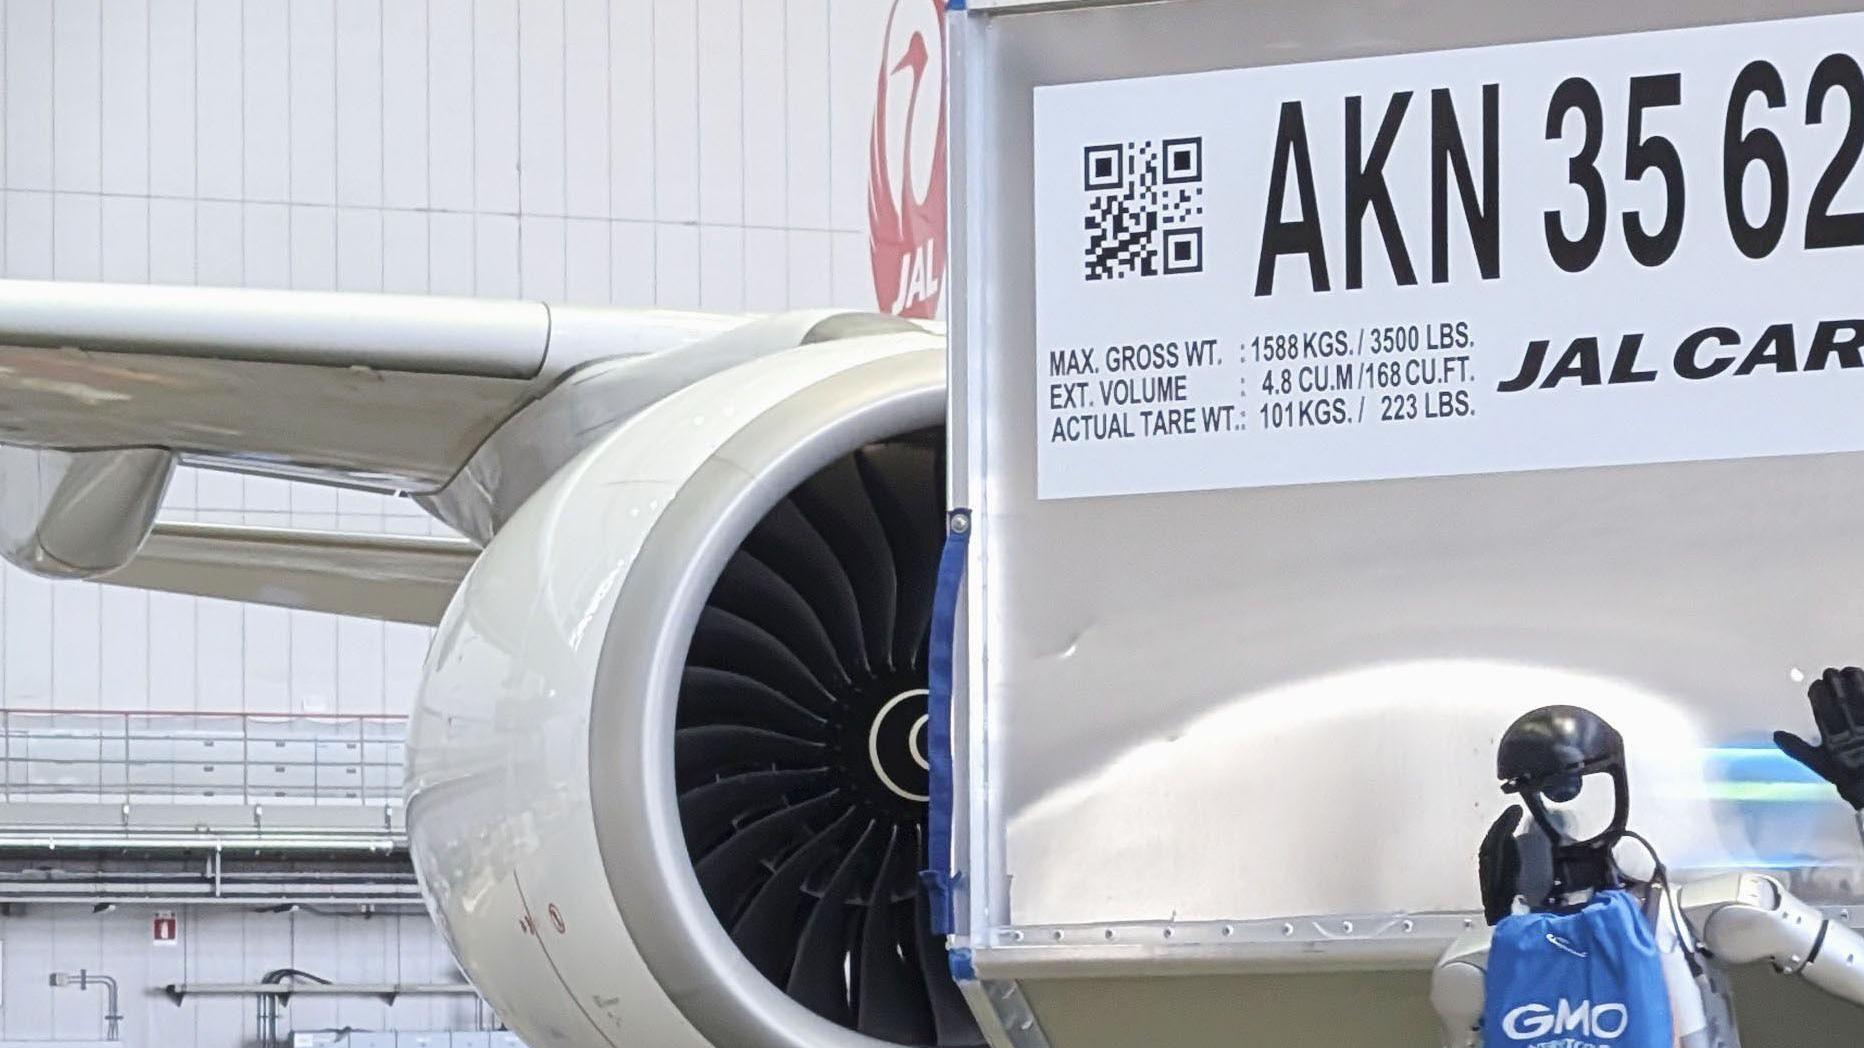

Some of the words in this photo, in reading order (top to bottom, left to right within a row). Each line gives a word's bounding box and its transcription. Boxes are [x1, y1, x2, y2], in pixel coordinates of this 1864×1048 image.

[1254, 82, 1501, 297] AKN
[1050, 347, 1100, 377] MAX.
[1105, 341, 1180, 373] GROSS
[1185, 339, 1223, 367] WT.
[1251, 333, 1299, 363] 1588
[1303, 330, 1354, 359] KGS.
[1370, 325, 1420, 354] 3500
[1426, 321, 1475, 351] LBS.
[1050, 382, 1095, 410] EXT.
[1100, 375, 1188, 406] VOLUME
[1262, 368, 1293, 396] 4.8
[1298, 364, 1353, 393] CU.M
[1051, 412, 1136, 443] ACTUAL
[1139, 407, 1197, 437] TARE
[1260, 401, 1293, 430] 101
[1298, 397, 1353, 427] KGS.
[1381, 394, 1418, 422] 223
[1425, 389, 1476, 419] LBS.
[1502, 997, 1628, 1040] GMO
